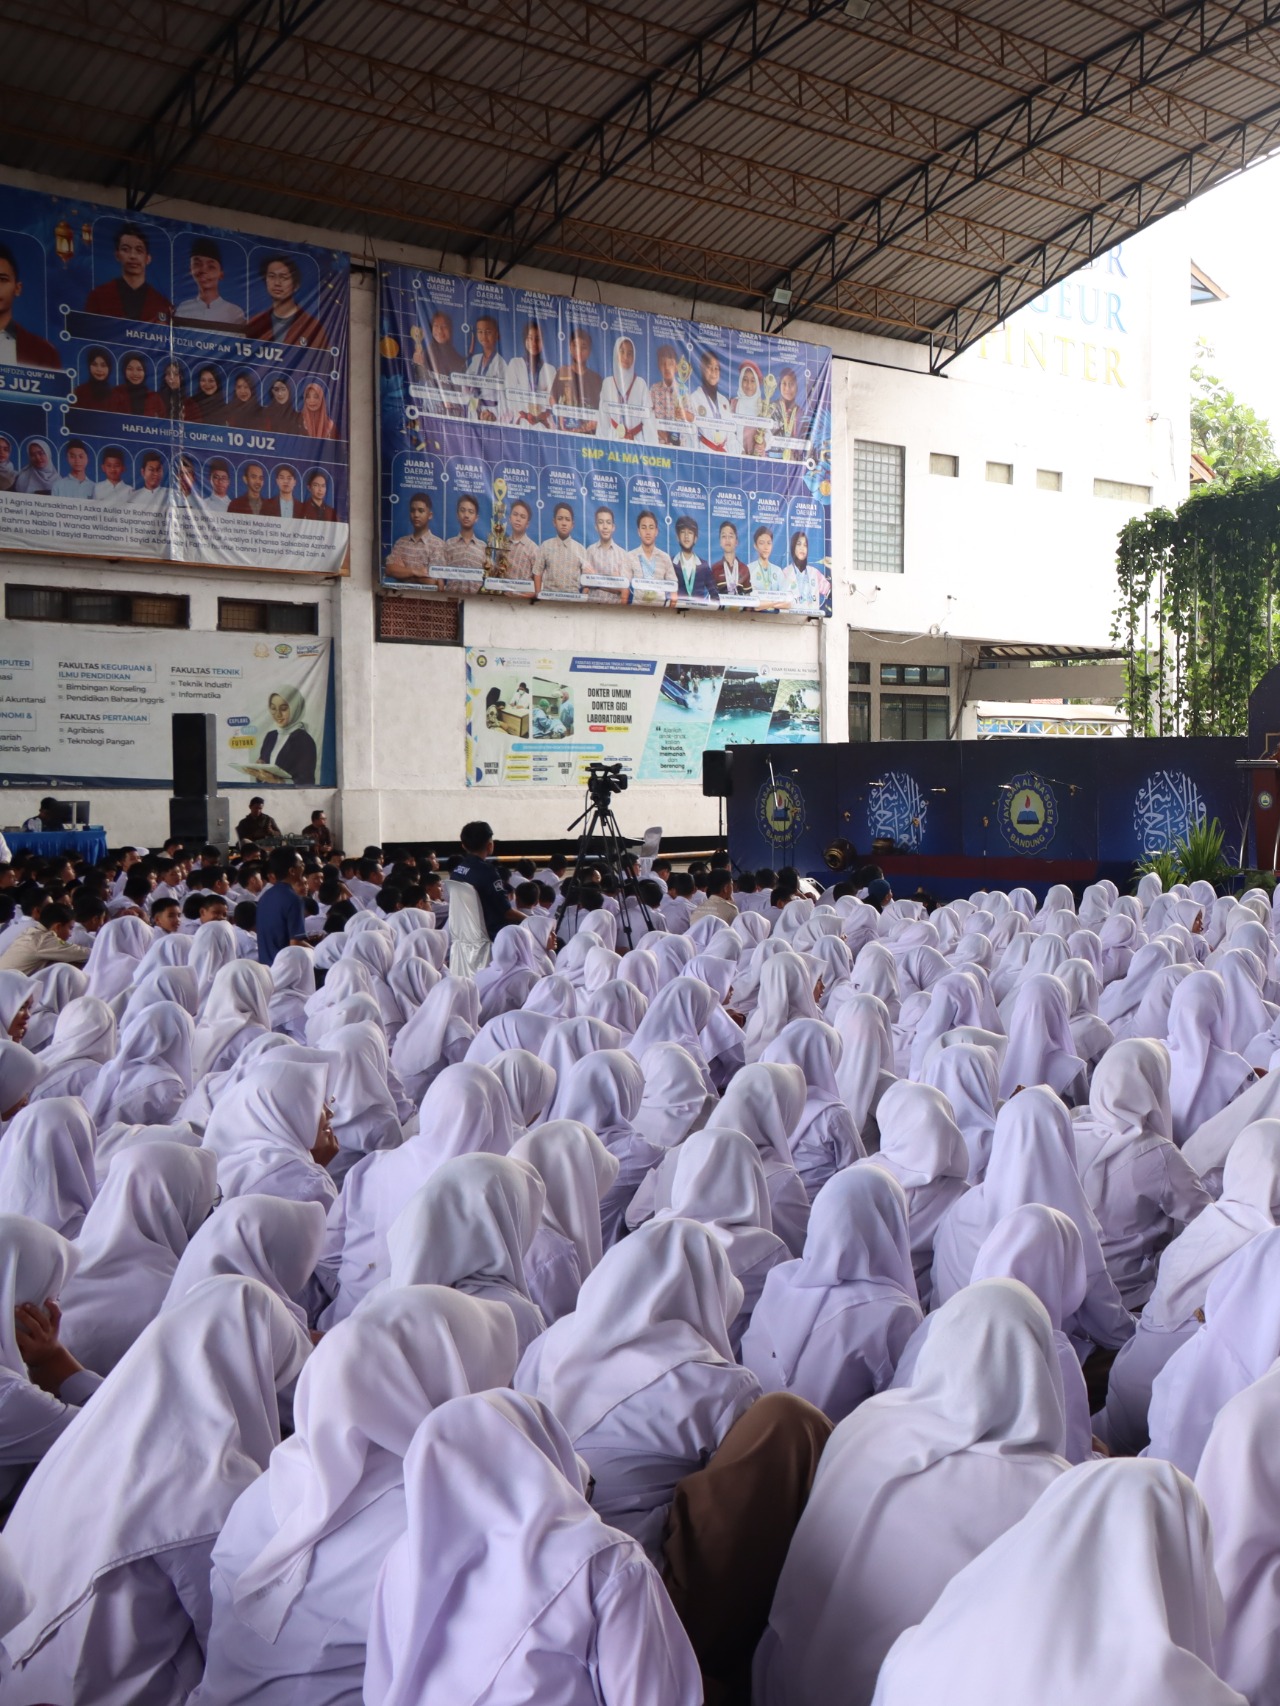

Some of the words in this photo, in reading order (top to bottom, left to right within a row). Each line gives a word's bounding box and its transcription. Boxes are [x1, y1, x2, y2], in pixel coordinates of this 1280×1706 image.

[427, 276, 450, 286] JUARA
[426, 282, 455, 293] DAERAH
[476, 284, 500, 293] JUARA
[476, 291, 504, 301] DAERAH
[524, 290, 547, 300] JUARA
[521, 297, 553, 308] NASIONAL
[566, 303, 598, 314] NASIONAL
[1028, 281, 1128, 334] GEUR
[607, 309, 646, 320] INTERNASIONAL
[654, 319, 683, 329] NASIONAL
[699, 323, 719, 331] JUARA
[698, 328, 722, 338] DAERAH
[739, 332, 758, 340] JUARA
[126, 329, 163, 343] HAFLAH
[235, 342, 252, 356] 15
[256, 347, 284, 362] JUZ
[739, 338, 761, 347] DAERAH
[778, 339, 796, 347] JUARA
[778, 345, 799, 353] DAERAH
[10, 378, 40, 393] JUZ
[122, 424, 158, 435] HAFLAH
[228, 432, 244, 446] 10
[247, 436, 275, 451] JUZ
[582, 447, 604, 459] SMP
[608, 451, 620, 462] AL
[404, 460, 430, 468] JUARA
[455, 464, 479, 473] JUARA
[404, 467, 434, 476] DAERAH
[456, 472, 483, 480] DAERAH
[502, 468, 525, 476] JUARA
[549, 470, 571, 479] JUARA
[504, 475, 529, 483] DAERAH
[550, 478, 575, 486] DAERAH
[593, 474, 614, 482] JUARA
[593, 482, 618, 490] DAERAH
[633, 486, 662, 495] NASIONAL
[671, 492, 707, 500] INTERNASIONAL
[717, 492, 737, 500] JUARA
[716, 499, 742, 507] NASIONAL
[795, 502, 814, 510] JUARA
[5, 508, 24, 516] Dewi
[30, 510, 54, 519] Alpina
[56, 512, 98, 522] Damayanti
[10, 499, 33, 508] Agnia
[34, 500, 78, 511] Nursakinah
[104, 507, 122, 515] Aulia
[133, 510, 163, 518] Rohman
[253, 521, 282, 529] Maulana
[32, 519, 57, 528] Nabila
[63, 522, 90, 531] Wanda
[92, 524, 129, 533] Wildaniah
[26, 528, 50, 536] Habibi
[56, 530, 81, 540] Rasyid
[83, 532, 124, 542] Ramadhan
[58, 662, 99, 670] FAKULTAS
[101, 664, 145, 672] KEGURUAN
[80, 672, 131, 680] PENDIDIKAN
[212, 668, 240, 676] TEKNIK
[66, 683, 108, 692] Bimbingan
[110, 685, 146, 694] Konseling
[178, 680, 203, 688] Teknik
[178, 692, 221, 700] Informatika
[588, 688, 610, 698] DOKTER
[612, 689, 632, 699] UMUM
[6, 696, 46, 704] Akuntansi
[66, 695, 109, 703] Pendidikan
[110, 696, 138, 704] Bahasa
[140, 696, 165, 705] Inggris
[592, 701, 614, 711] DOKTER
[616, 702, 628, 711] GIGI
[60, 713, 100, 721] FAKULTAS
[102, 714, 148, 722] PERTANIAN
[587, 714, 632, 724] LABORATORIUM
[68, 727, 104, 736] Agribisnis
[68, 738, 104, 747] Teknologi
[106, 738, 135, 747] Pangan
[22, 745, 51, 754] Syariah
[1003, 782, 1021, 824] YAYASAN
[1022, 779, 1032, 787] AL
[1010, 833, 1045, 848] BANDUNG
